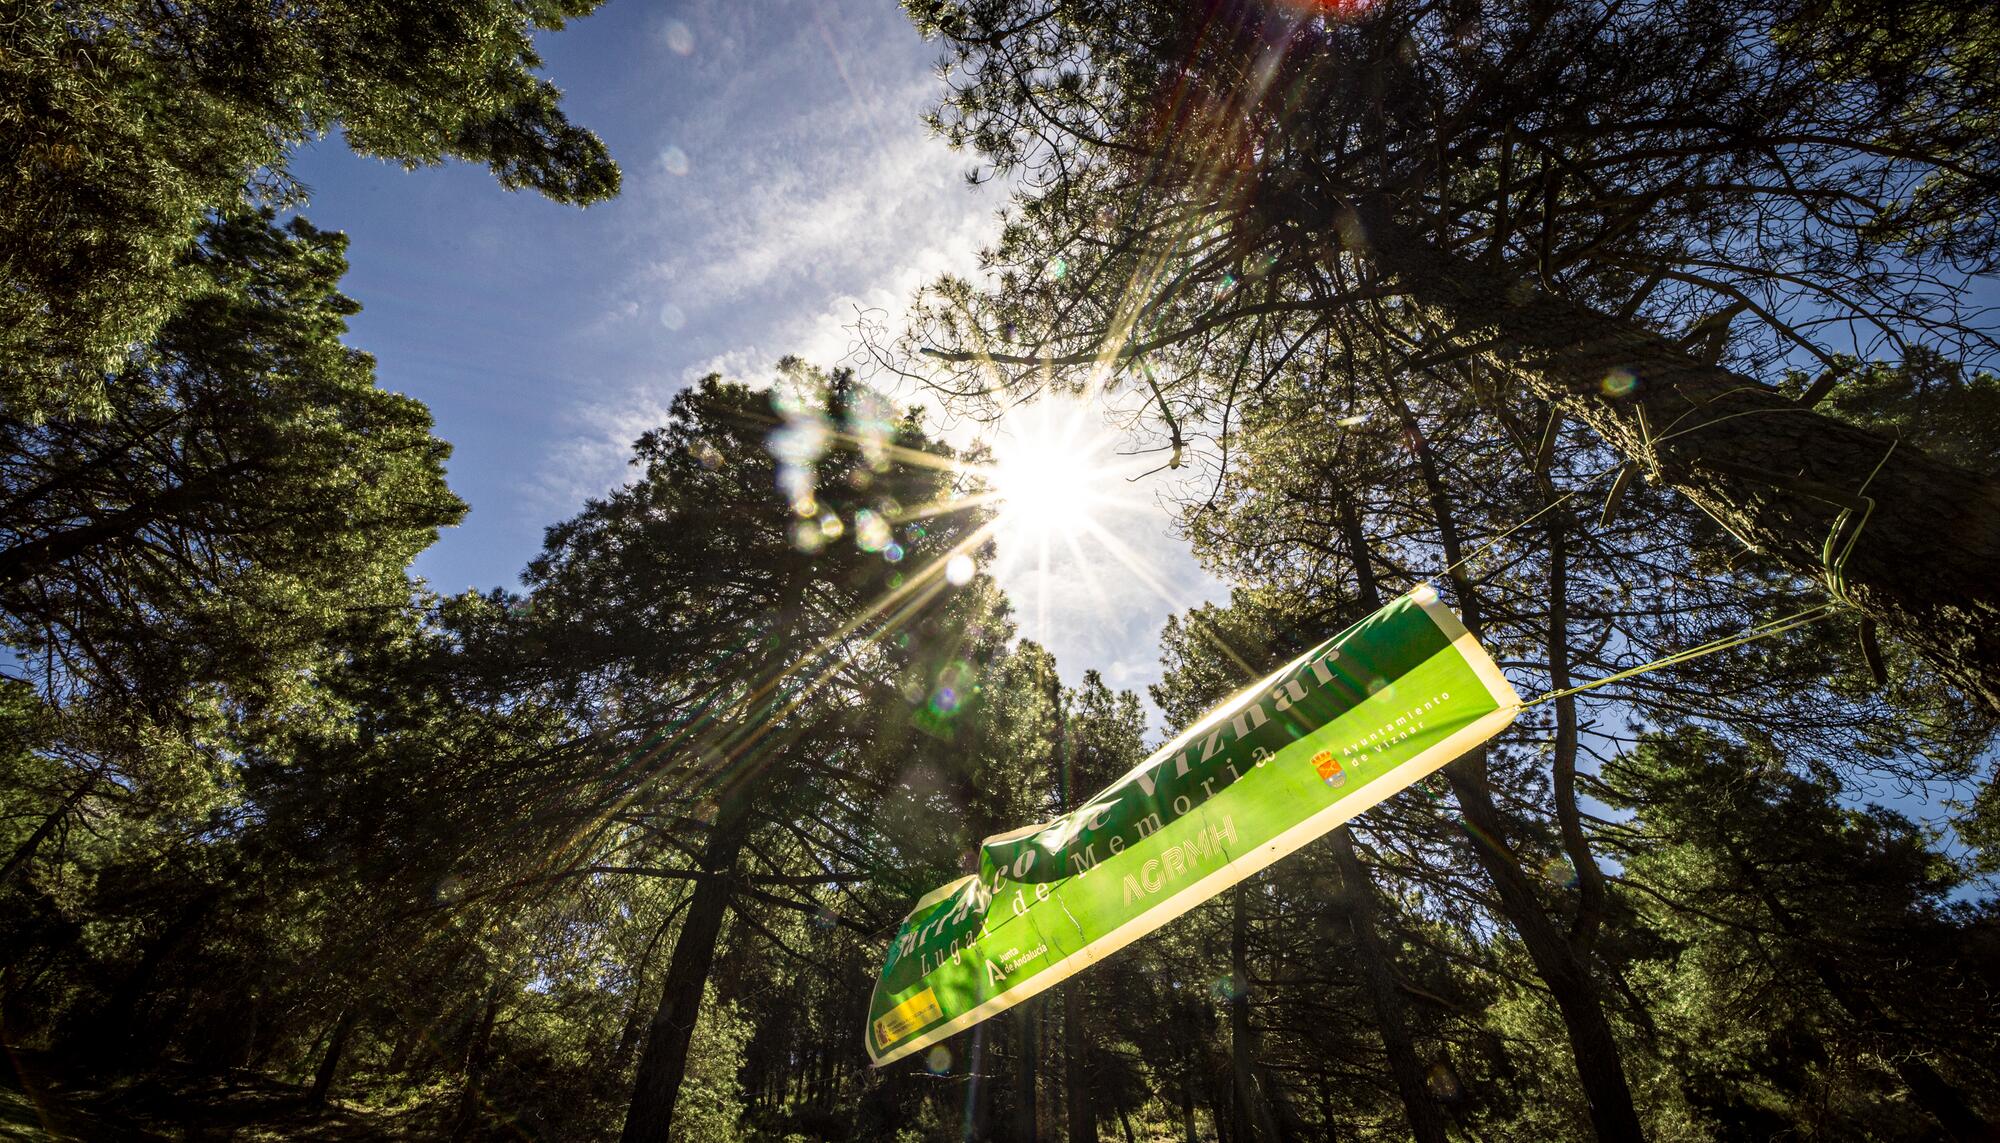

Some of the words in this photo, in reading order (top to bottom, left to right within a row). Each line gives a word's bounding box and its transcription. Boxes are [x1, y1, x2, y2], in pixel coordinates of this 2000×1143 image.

[1343, 692, 1450, 757] Ayuntamiento
[1351, 753, 1369, 768] de
[920, 917, 992, 978] Lugar
[1012, 883, 1051, 917] de
[1071, 746, 1276, 880] Memoria
[1123, 815, 1239, 908] AGRMH
[999, 947, 1020, 963] Junta
[1004, 963, 1015, 974] de
[1013, 943, 1048, 969] Andalucía
